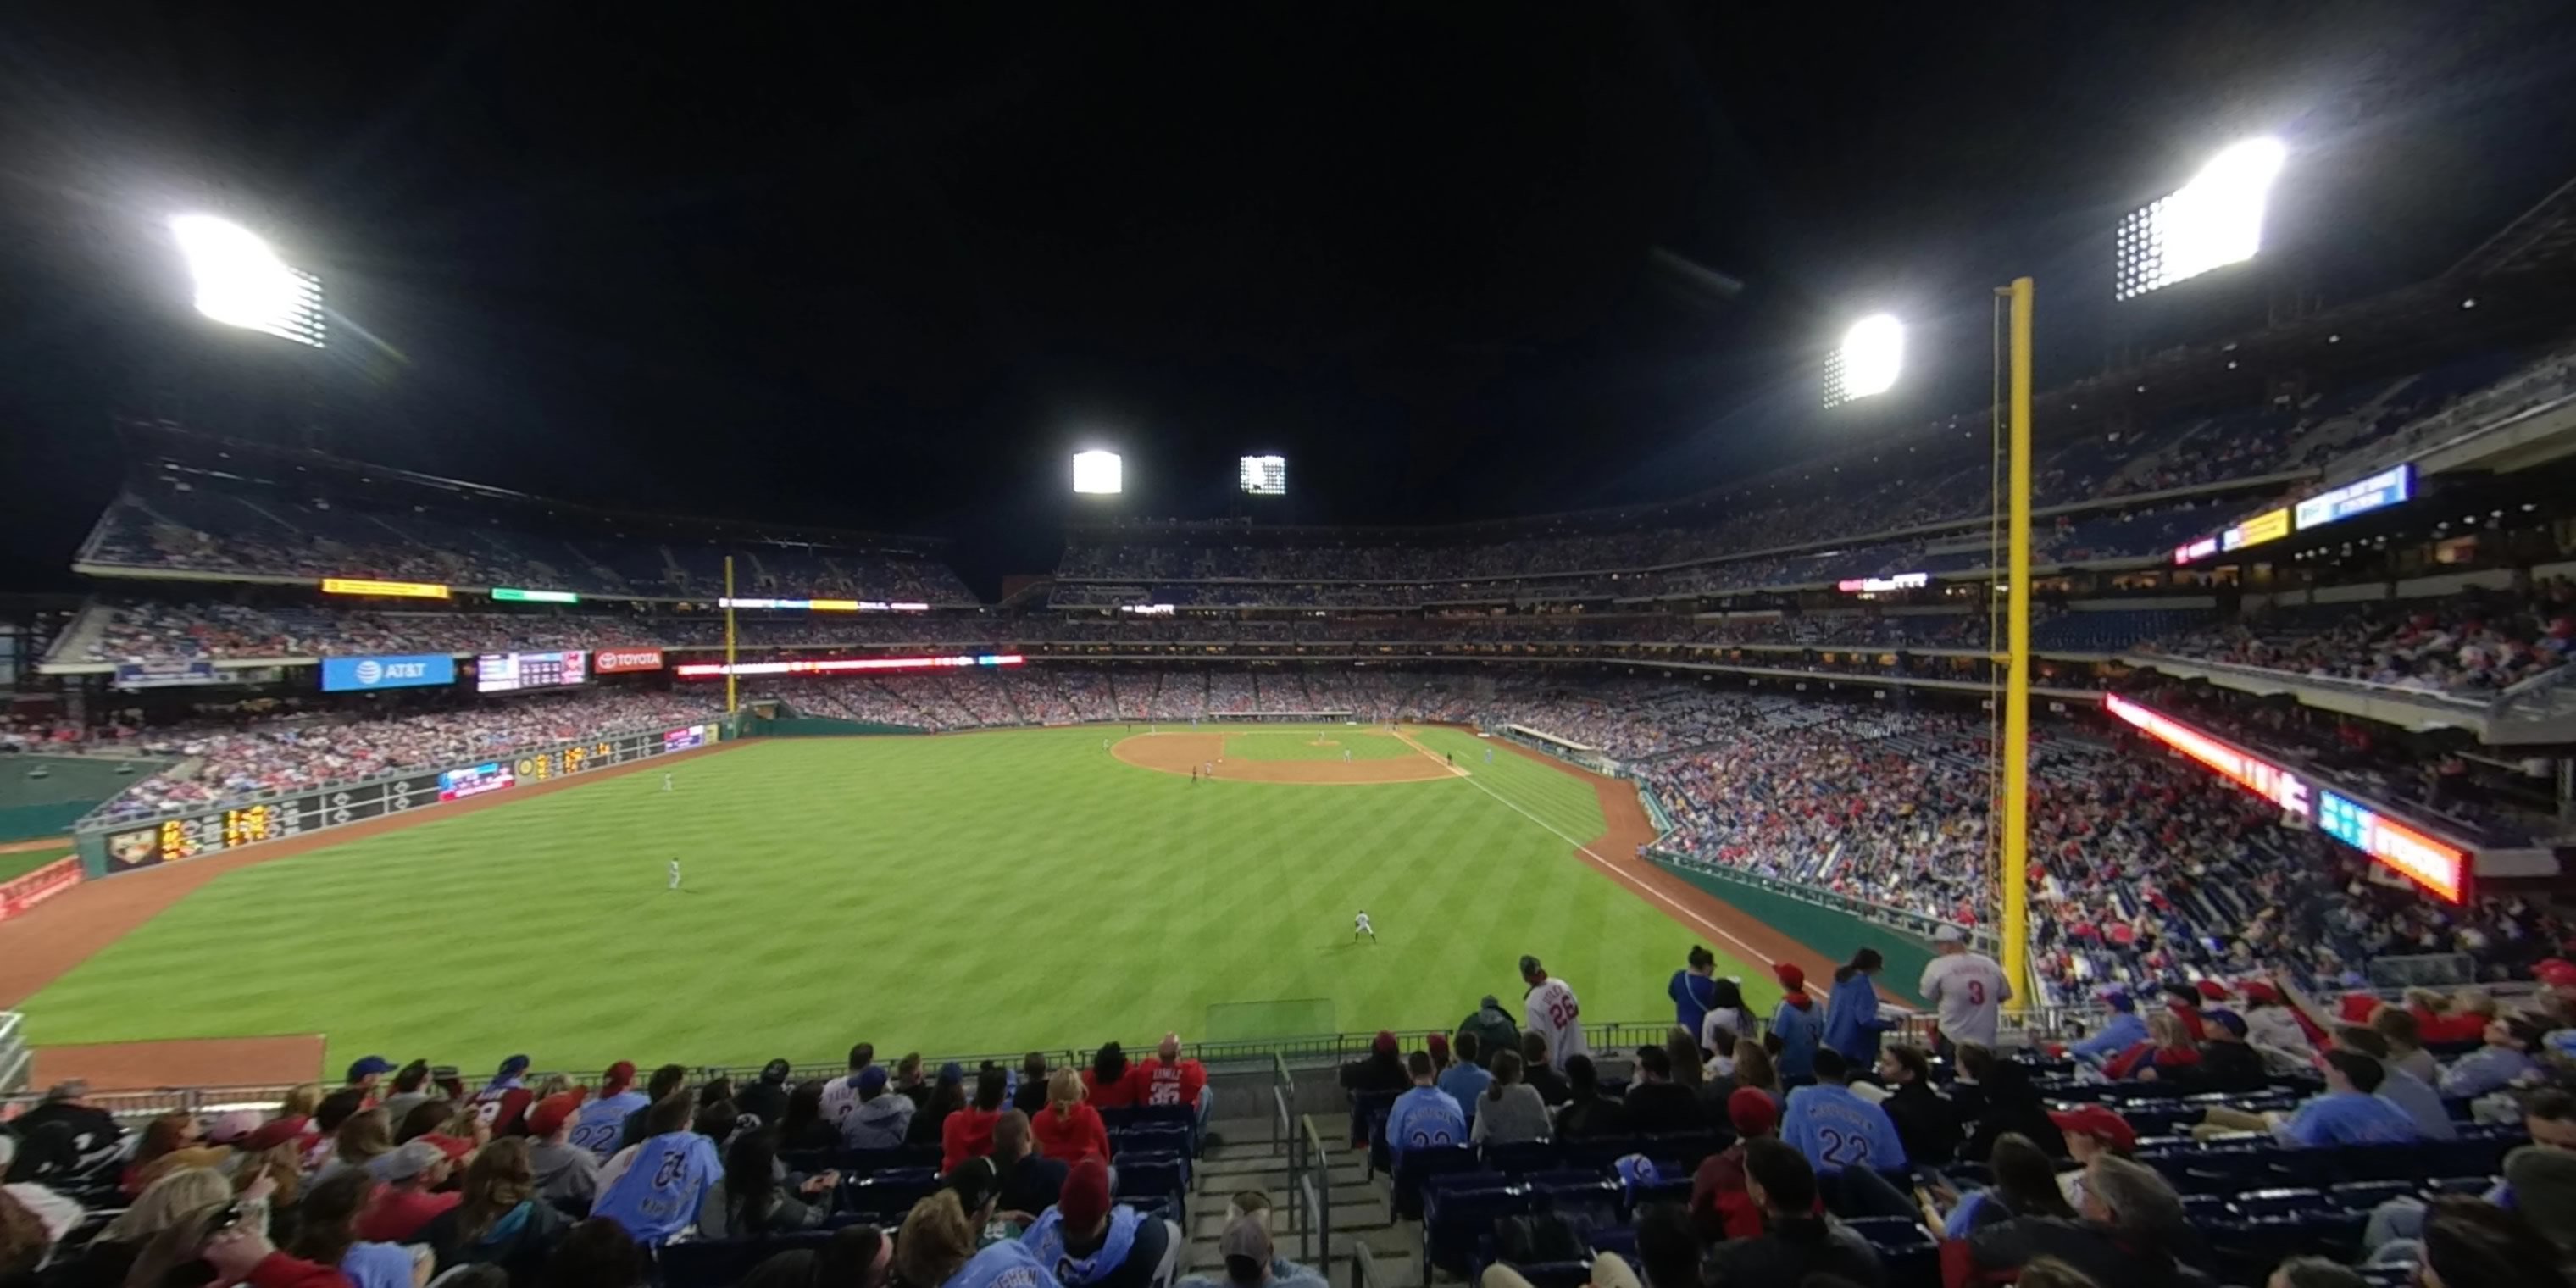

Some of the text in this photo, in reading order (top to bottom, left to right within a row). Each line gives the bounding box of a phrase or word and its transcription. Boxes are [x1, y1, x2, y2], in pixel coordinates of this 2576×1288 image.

[385, 663, 427, 678] AT&T
[616, 652, 660, 666] TOYOTA
[1968, 980, 1985, 1006] 3
[1549, 994, 1579, 1030] 26
[574, 1124, 616, 1152] 22
[1819, 1128, 1868, 1167] 22
